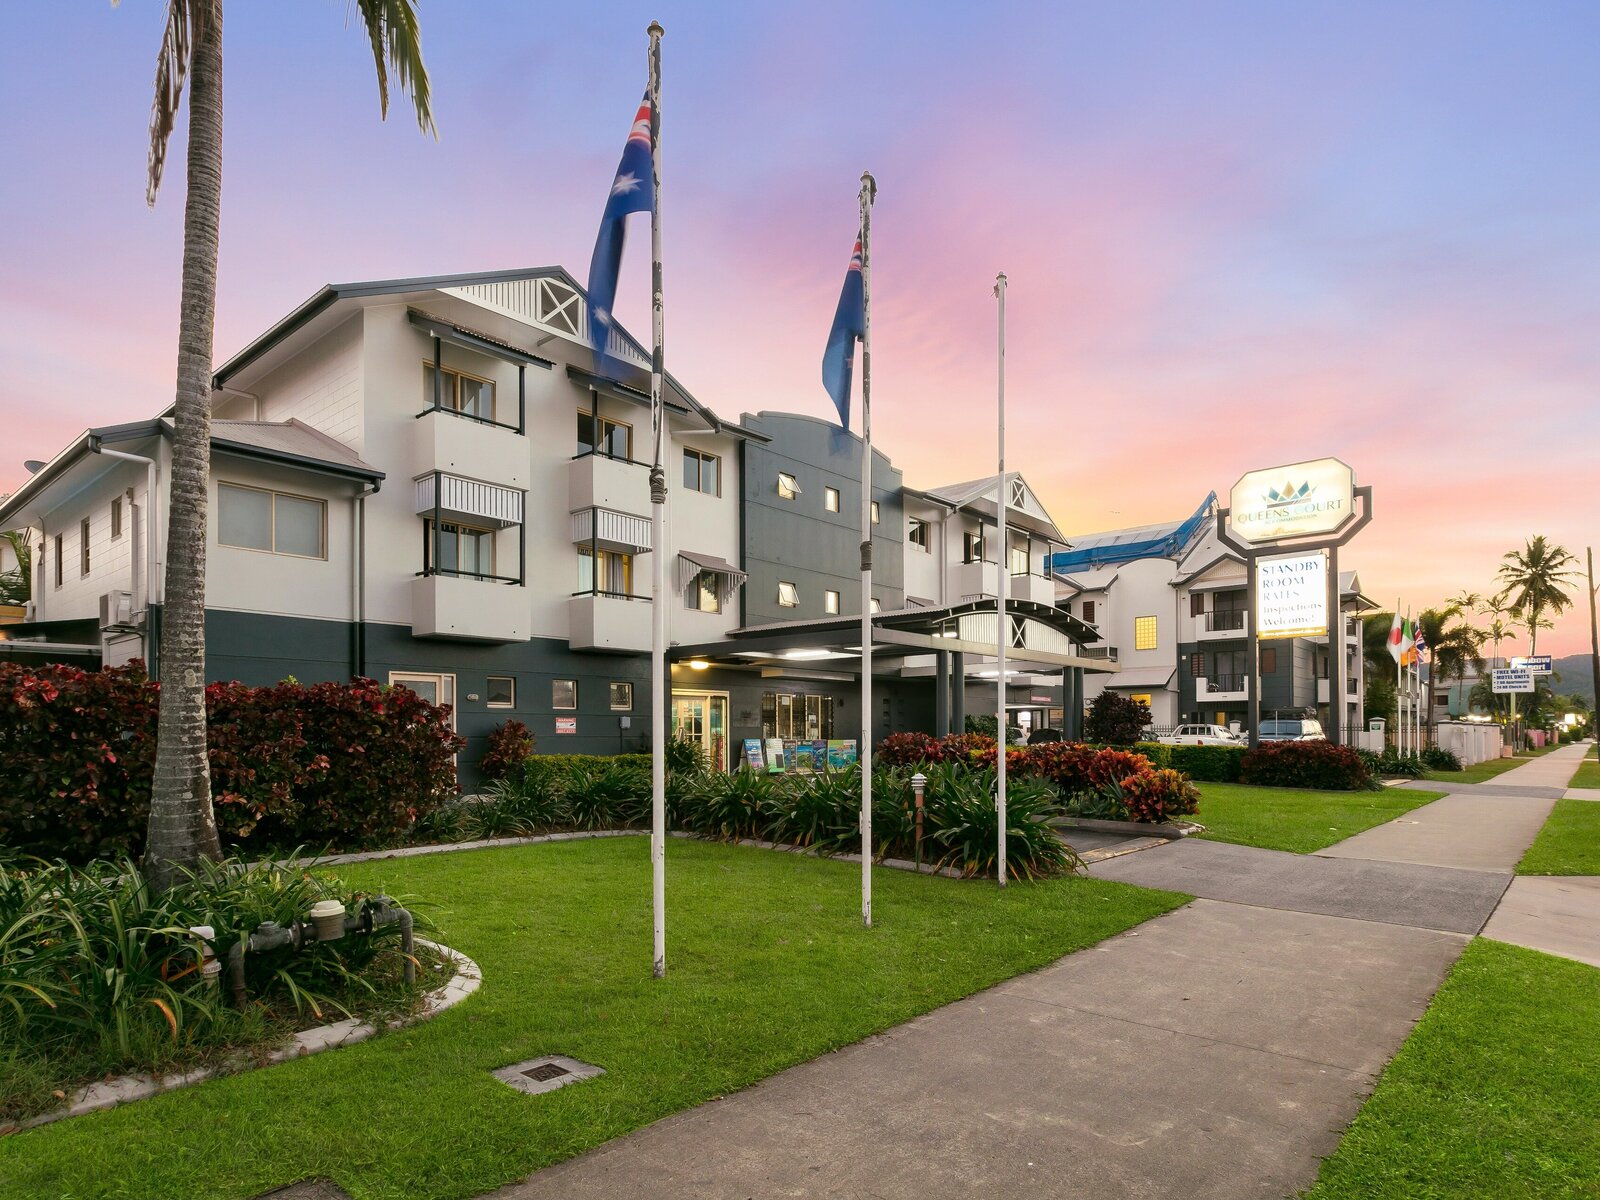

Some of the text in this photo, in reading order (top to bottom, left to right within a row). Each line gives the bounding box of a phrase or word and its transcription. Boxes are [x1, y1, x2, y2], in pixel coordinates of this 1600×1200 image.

[1238, 499, 1343, 523] QUEENS COURT
[1262, 561, 1319, 575] STANDBY
[1263, 576, 1304, 589] ROOM
[1263, 603, 1322, 615] Inspections
